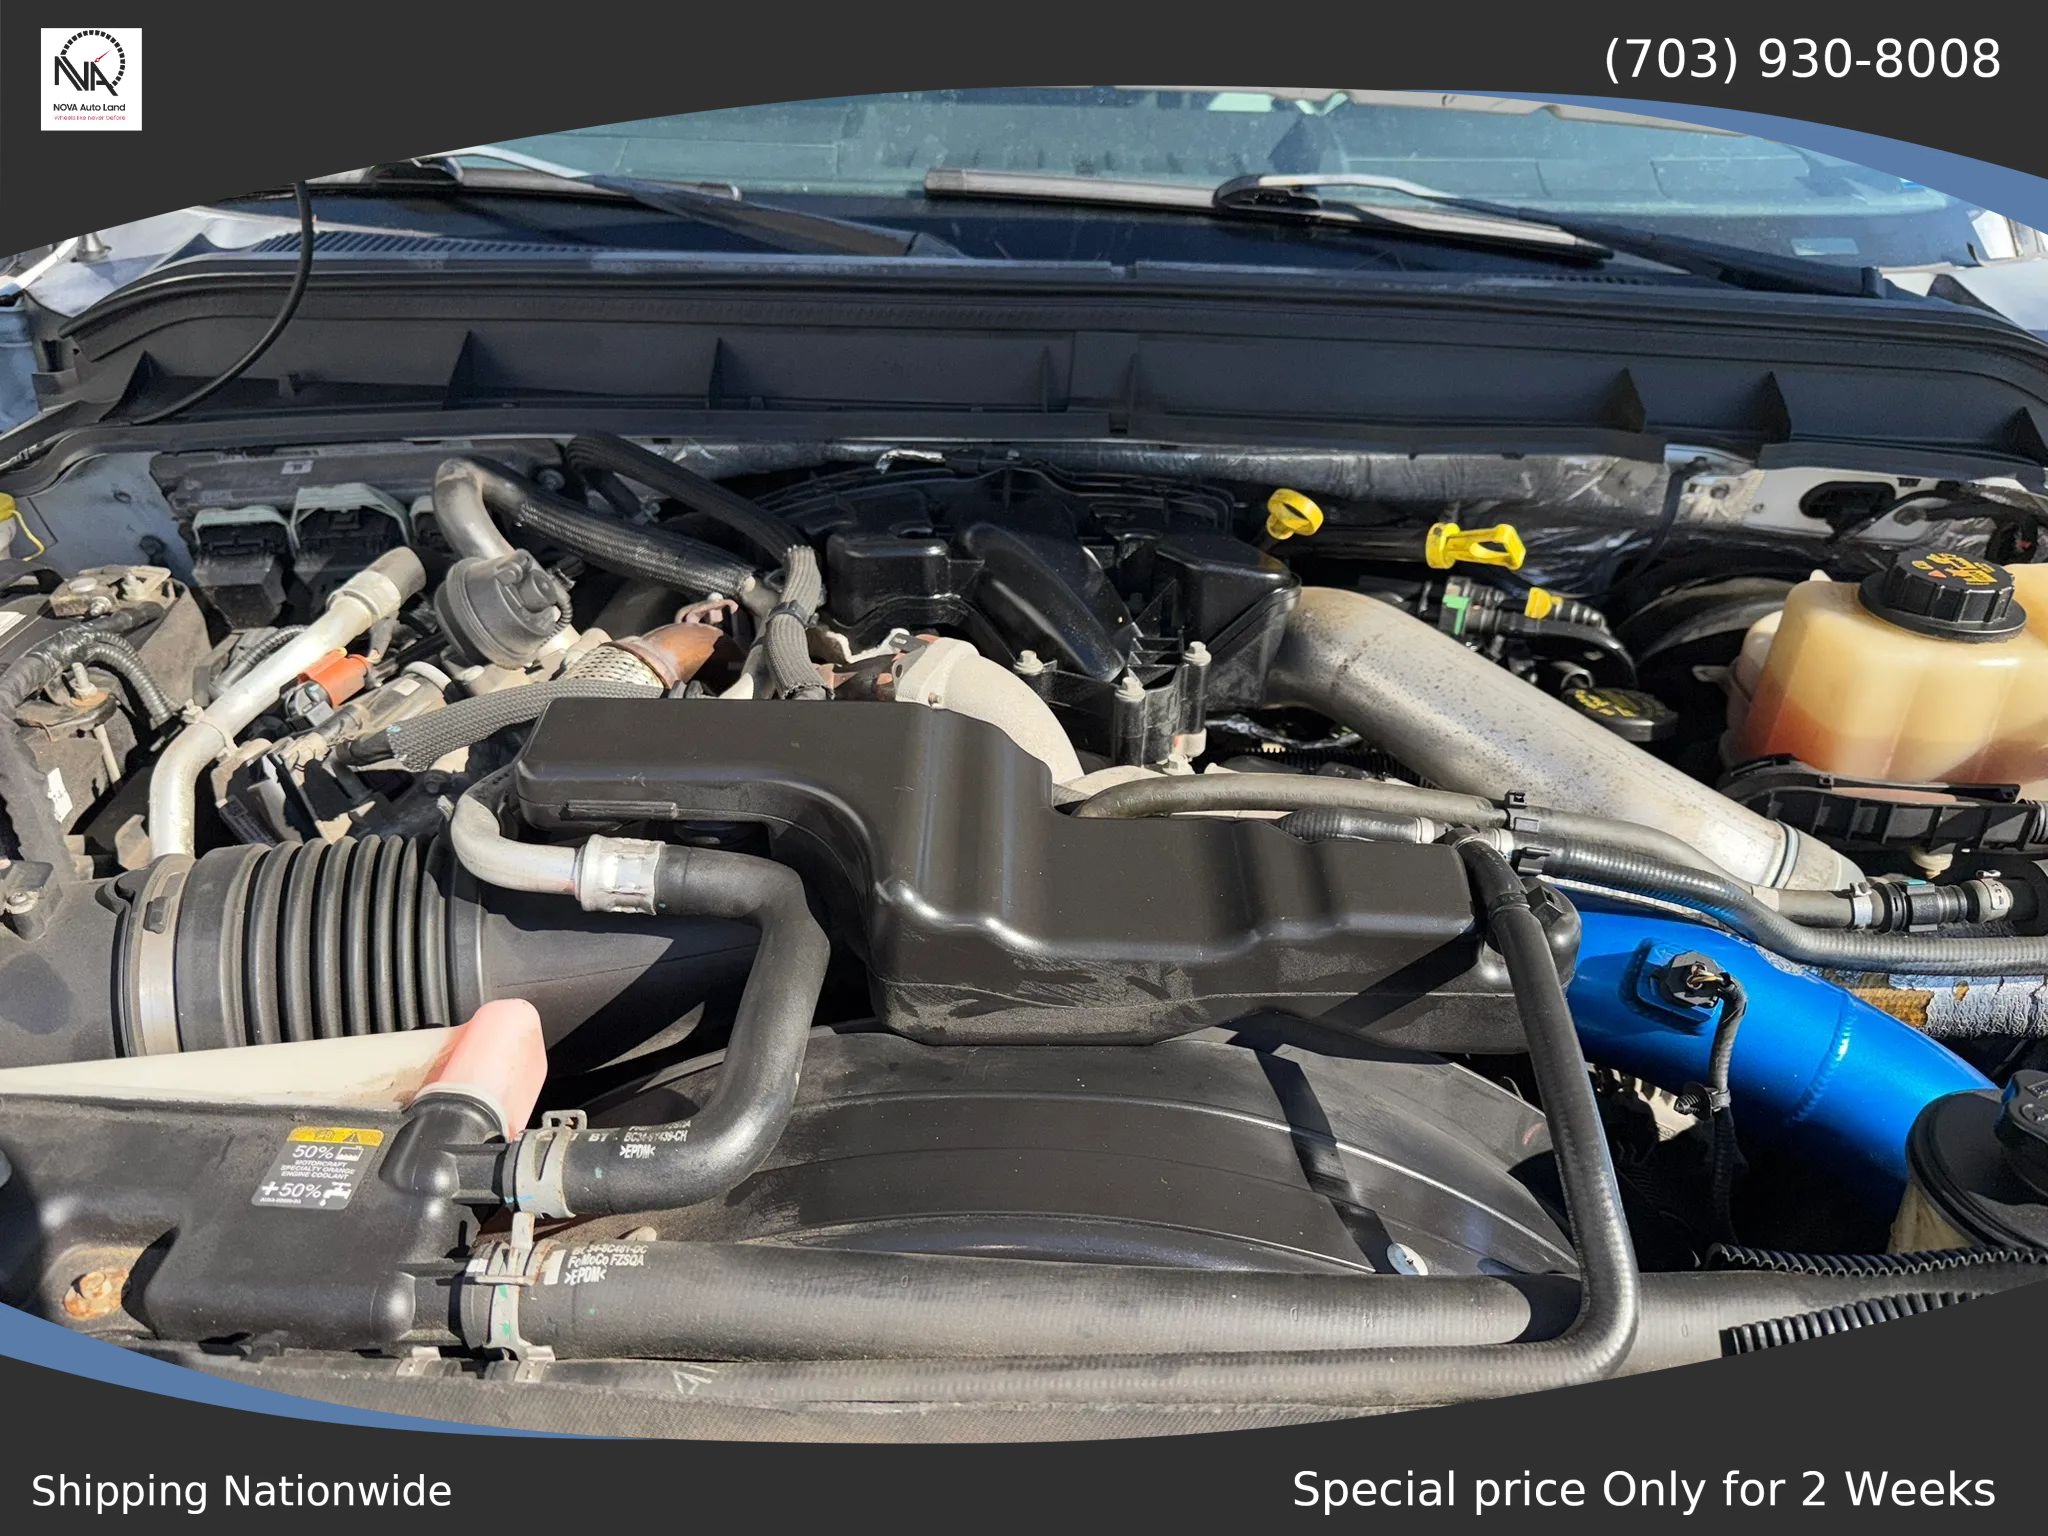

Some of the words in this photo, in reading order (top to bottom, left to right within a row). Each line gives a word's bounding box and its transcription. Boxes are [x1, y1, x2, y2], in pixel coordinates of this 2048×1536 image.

[292, 1144, 334, 1160] 50%
[294, 1159, 348, 1168] MOTORCRAFT
[280, 1164, 322, 1172] SPECIALTY
[321, 1167, 356, 1175] ORANGE
[311, 1172, 349, 1180] COOLANT
